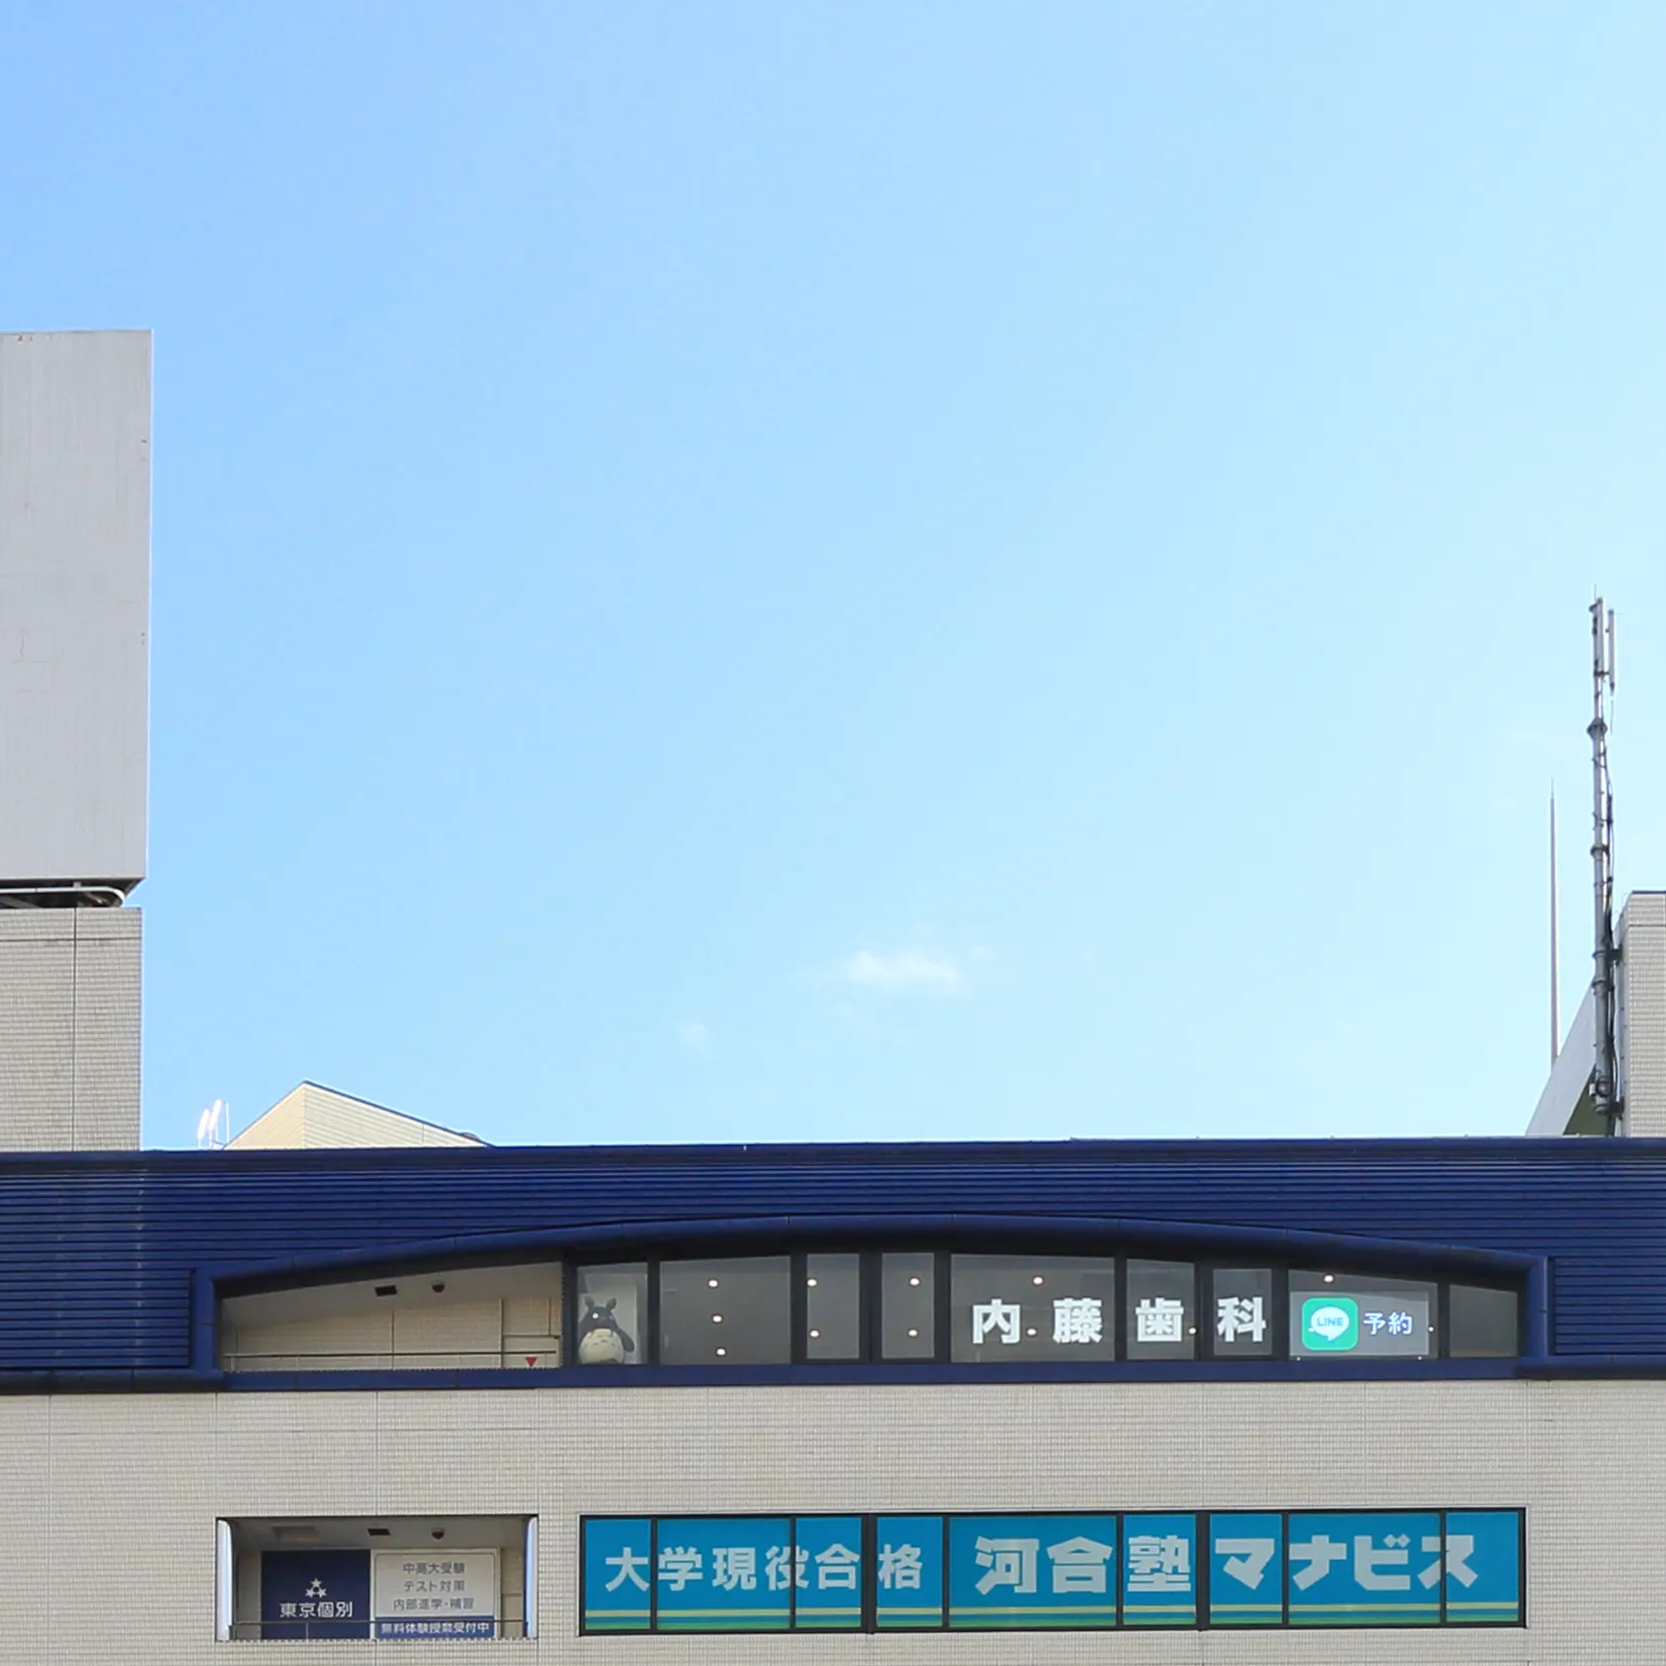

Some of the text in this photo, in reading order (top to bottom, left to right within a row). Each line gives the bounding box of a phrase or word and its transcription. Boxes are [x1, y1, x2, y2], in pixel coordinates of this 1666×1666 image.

[971, 1297, 1267, 1345] 内藤歯科
[1316, 1315, 1344, 1329] LINE
[1362, 1311, 1413, 1336] 予約
[604, 1543, 923, 1592] 大学現役合格
[279, 1601, 353, 1619] 東京個別
